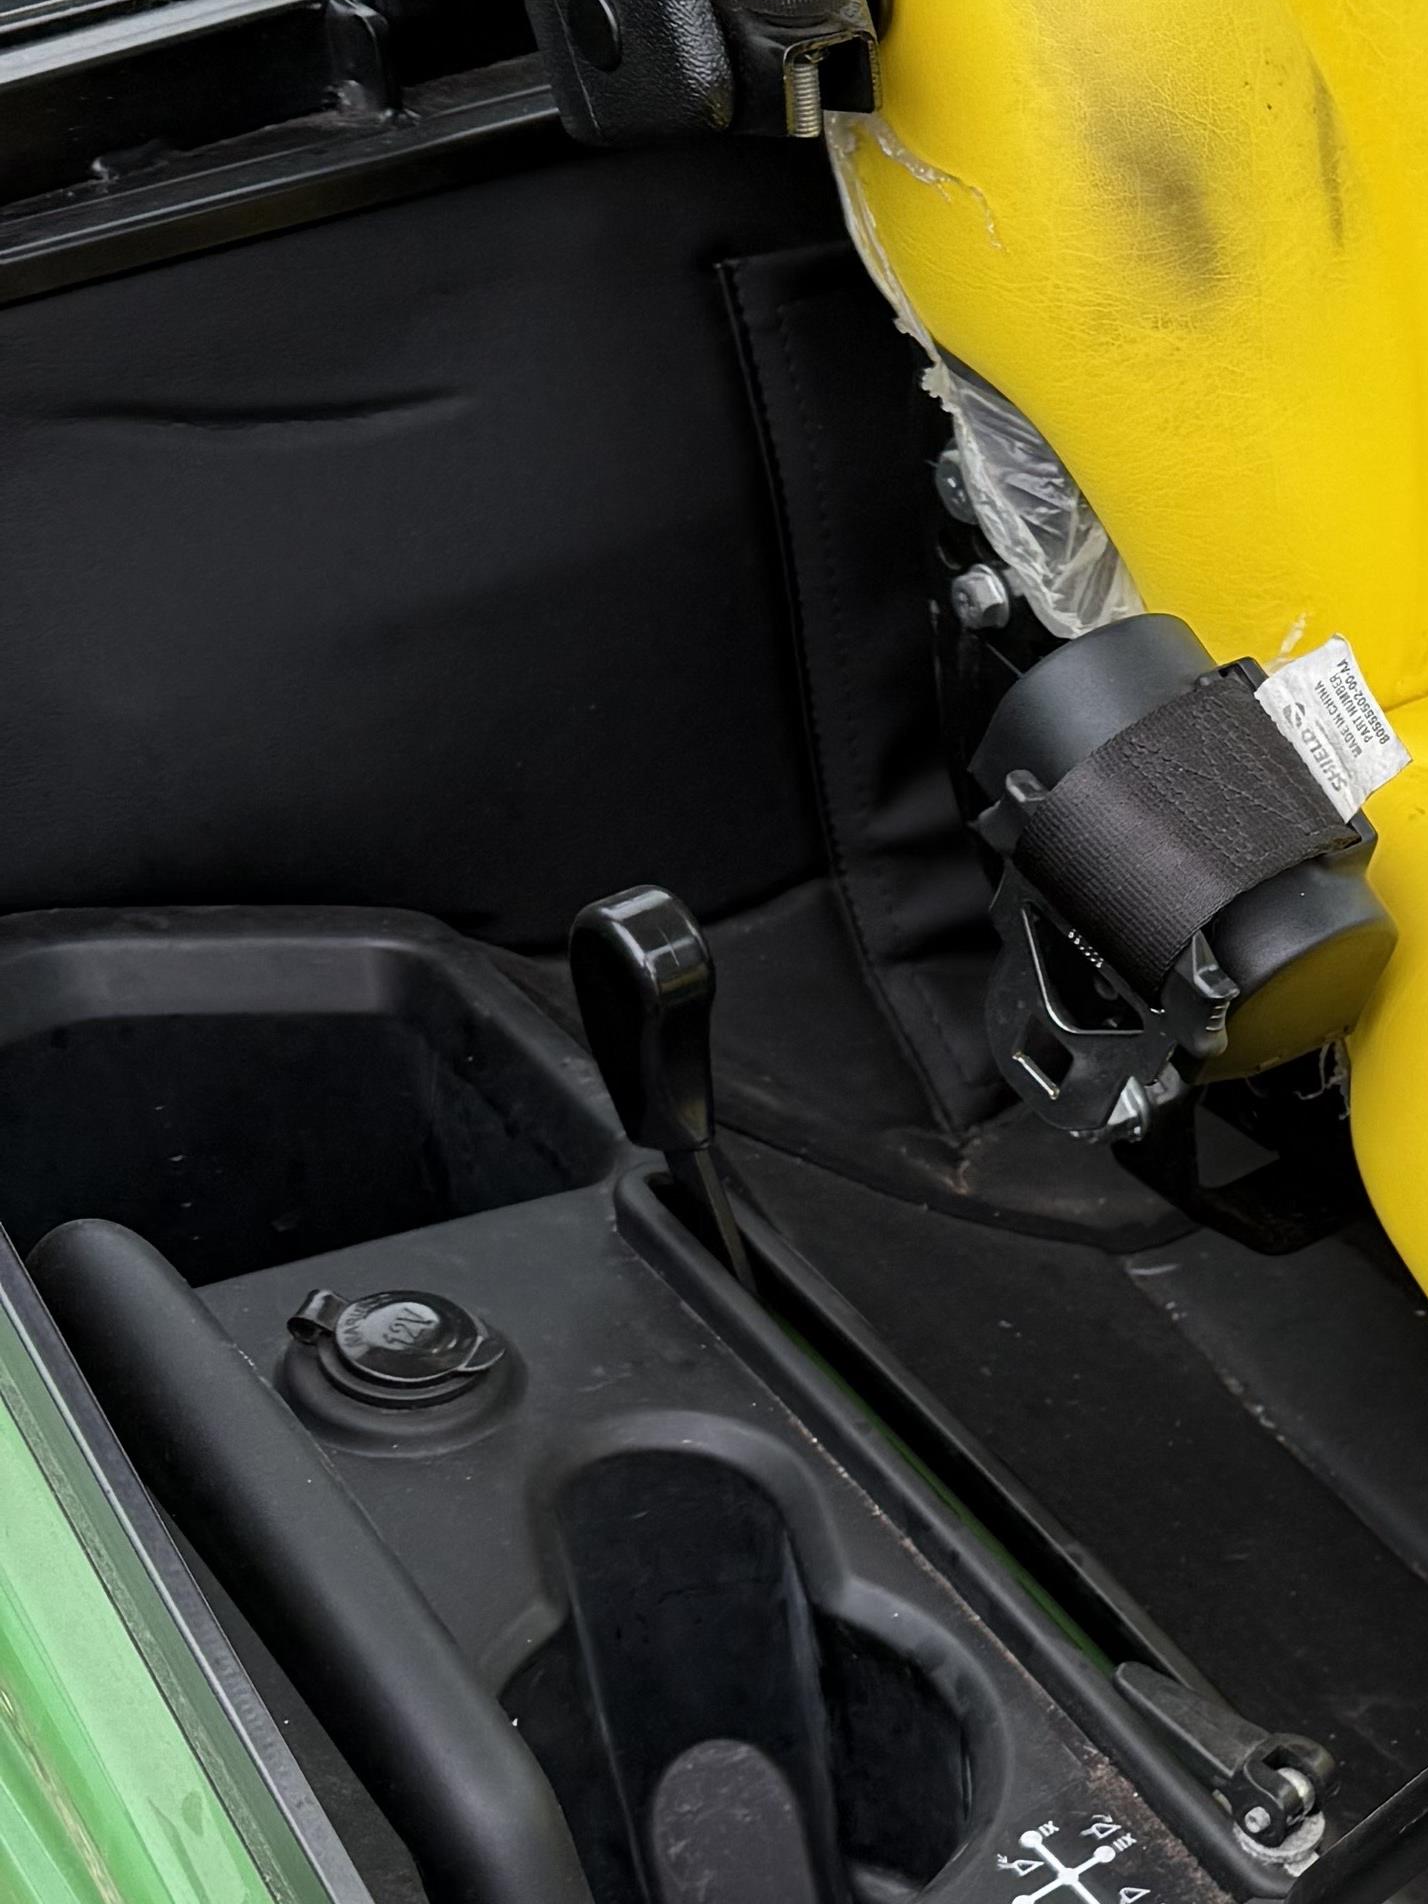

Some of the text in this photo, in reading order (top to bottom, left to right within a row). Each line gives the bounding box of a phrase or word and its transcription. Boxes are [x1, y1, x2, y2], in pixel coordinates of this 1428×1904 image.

[1314, 680, 1363, 758] MADE IN CHINA
[1329, 672, 1374, 743] PART NUMBER
[1301, 728, 1348, 792] SHIELD
